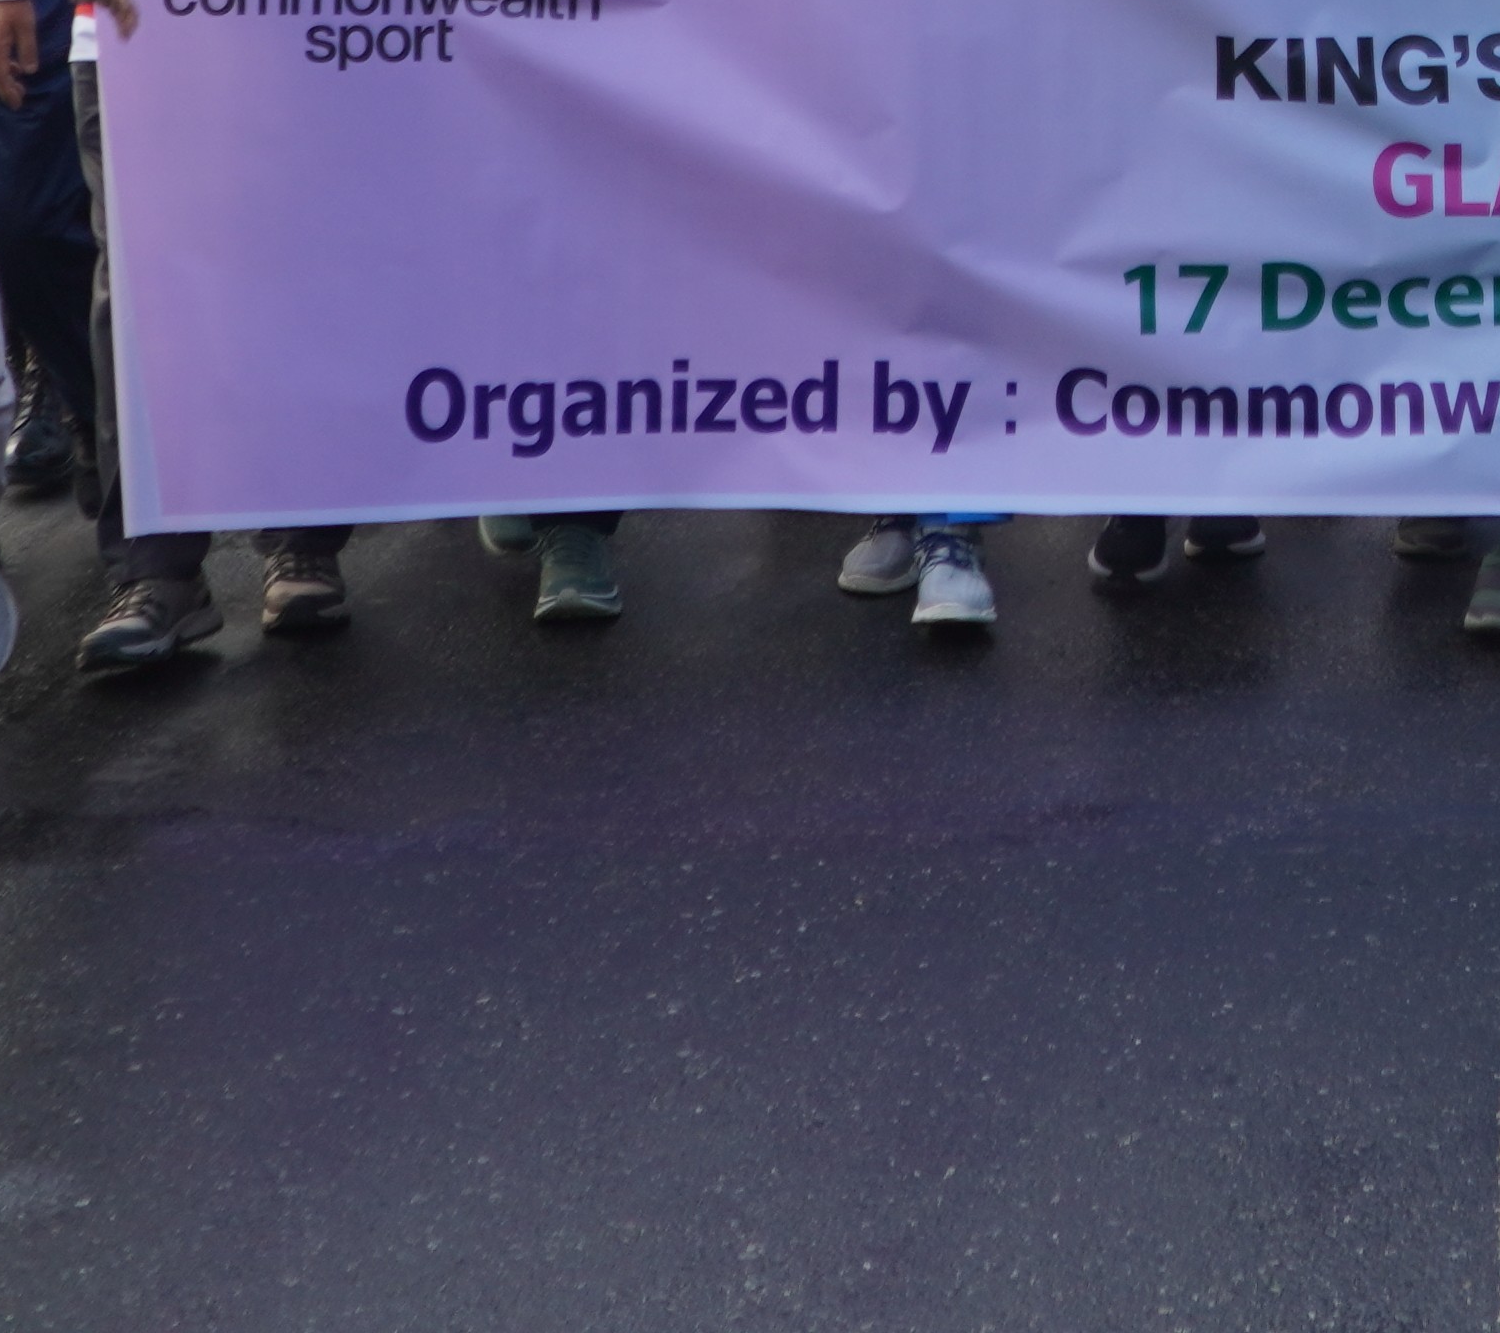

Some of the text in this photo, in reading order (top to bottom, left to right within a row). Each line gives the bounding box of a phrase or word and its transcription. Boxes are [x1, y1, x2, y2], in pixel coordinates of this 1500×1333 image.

[305, 19, 453, 71] sport
[1123, 263, 1229, 336] 17
[405, 360, 839, 458] Organized
[873, 362, 972, 455] by
[1004, 382, 1018, 437] :
